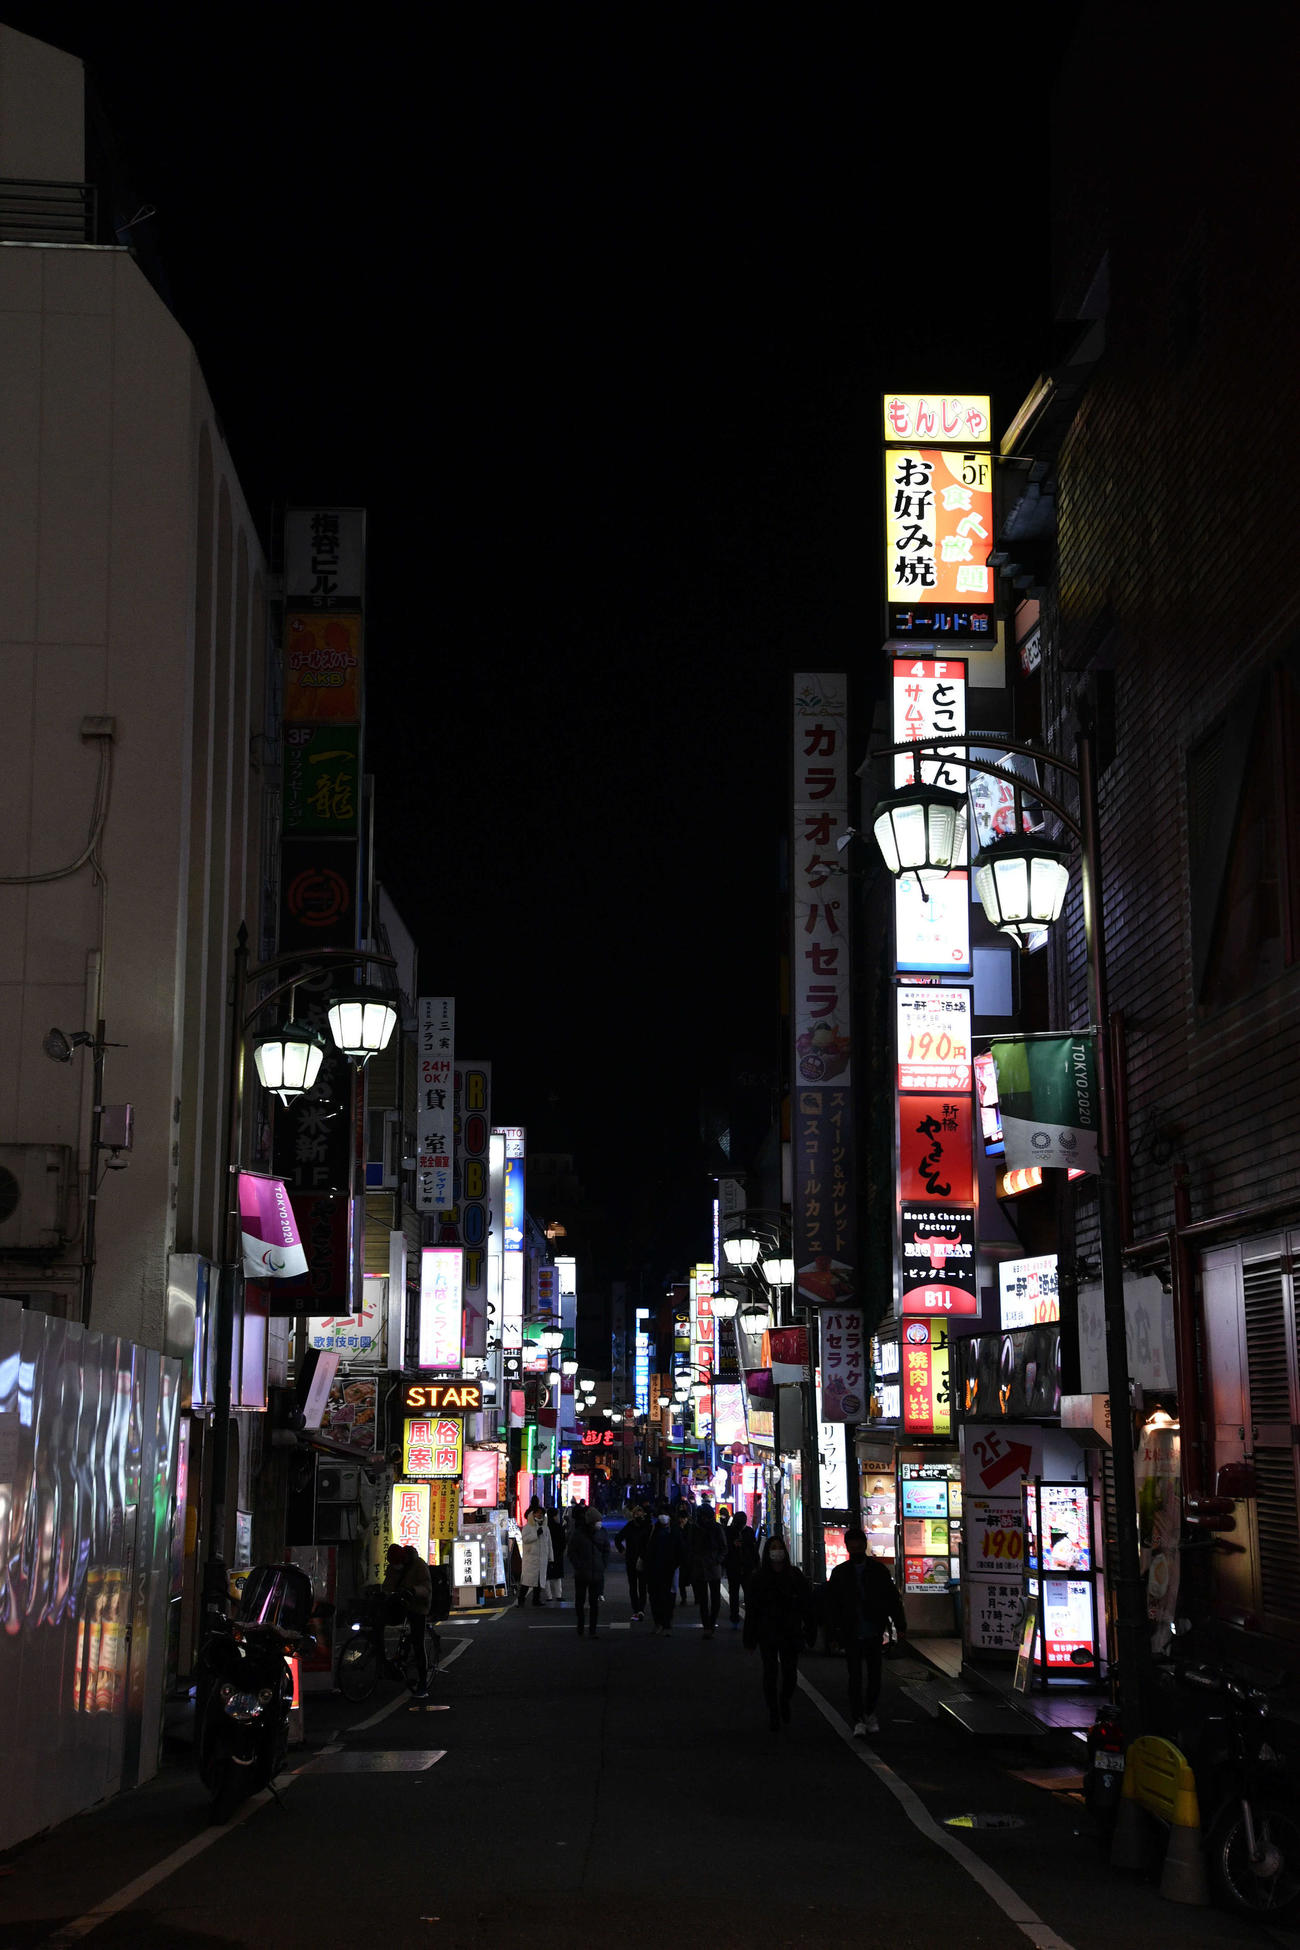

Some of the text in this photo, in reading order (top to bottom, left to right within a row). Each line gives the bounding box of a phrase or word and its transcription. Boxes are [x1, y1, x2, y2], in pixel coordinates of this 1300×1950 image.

[889, 398, 988, 438] もんじゃ
[962, 456, 988, 485] 5F
[894, 457, 936, 588] お好み焼
[896, 611, 989, 632] ゴールド館
[300, 671, 345, 688] AKB
[288, 728, 313, 744] 3F
[907, 1032, 967, 1061] 190円
[422, 1061, 451, 1072] 24H
[424, 1073, 449, 1084] OK!
[1071, 1044, 1092, 1125] TOKYO 2020
[941, 1104, 959, 1131] 新橋
[915, 1114, 952, 1197] やきとん
[463, 1071, 487, 1289] ROBOT
[273, 1187, 295, 1244] TOKYO 2020
[904, 1212, 972, 1221] Meat & Cheese
[919, 1223, 957, 1232] Factory
[904, 1242, 931, 1257] BIG
[925, 1291, 942, 1307] B1
[826, 1315, 842, 1368] パセラ
[845, 1315, 862, 1388] カラオケ
[406, 1386, 481, 1407] STAR
[407, 1419, 461, 1446] 風俗
[407, 1446, 458, 1473] 案内
[973, 1430, 1002, 1468] 2F
[988, 1585, 1023, 1598] 営業時
